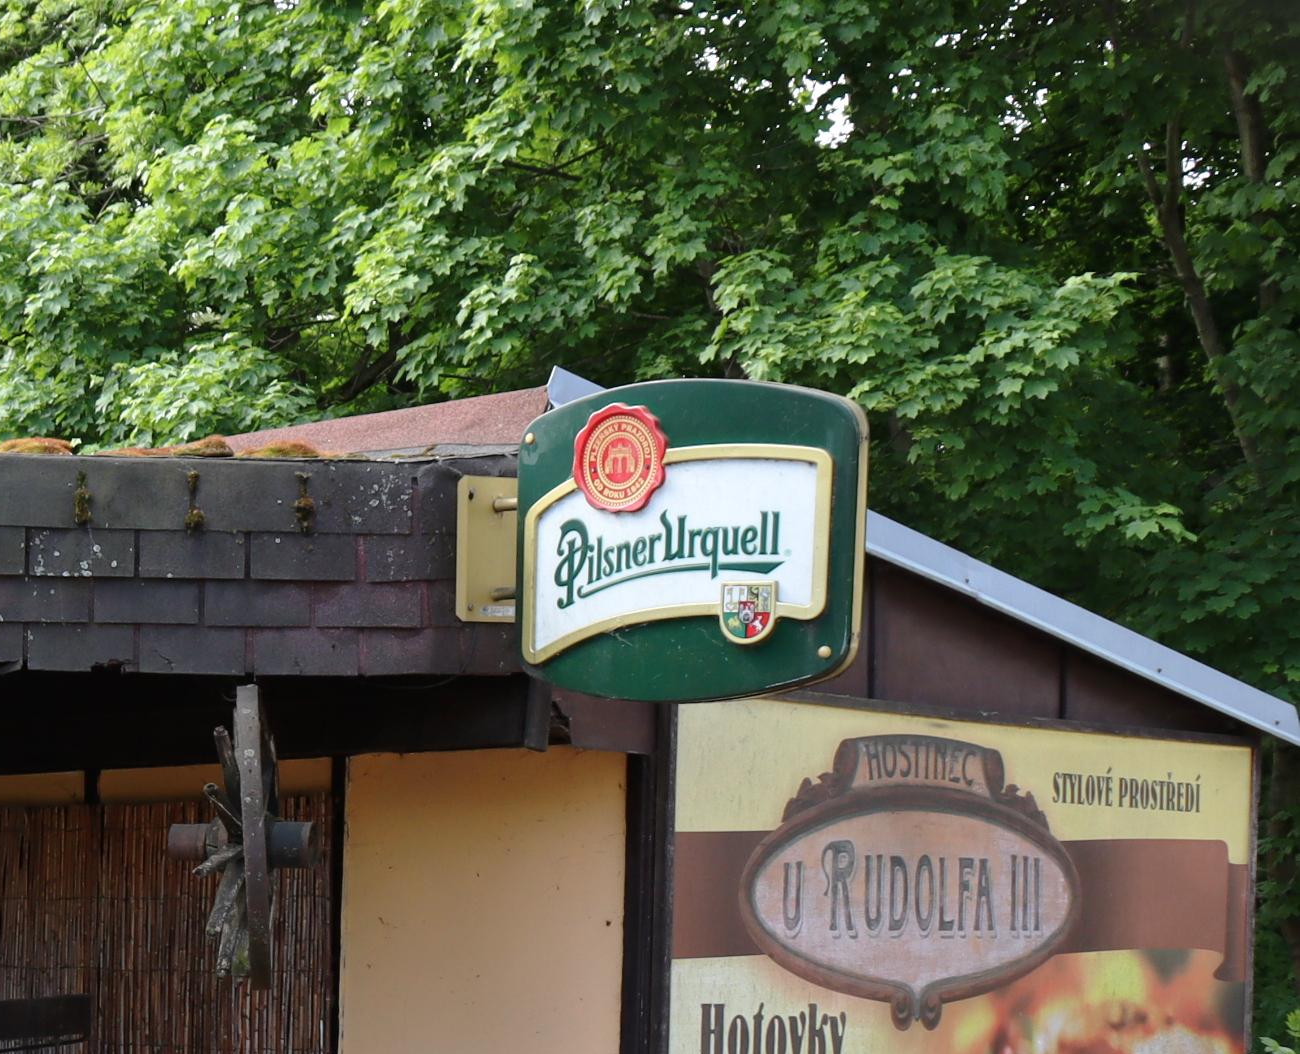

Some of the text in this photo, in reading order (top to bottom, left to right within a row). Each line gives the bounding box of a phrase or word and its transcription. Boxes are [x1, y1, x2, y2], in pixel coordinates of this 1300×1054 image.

[554, 509, 781, 609] Pilsner Urquell
[866, 743, 977, 787] HOSTINEC
[1052, 767, 1201, 813] STYLOVÉ PROSTŘEDÍ
[821, 840, 997, 939] RUDOLFA
[1010, 854, 1043, 939] III
